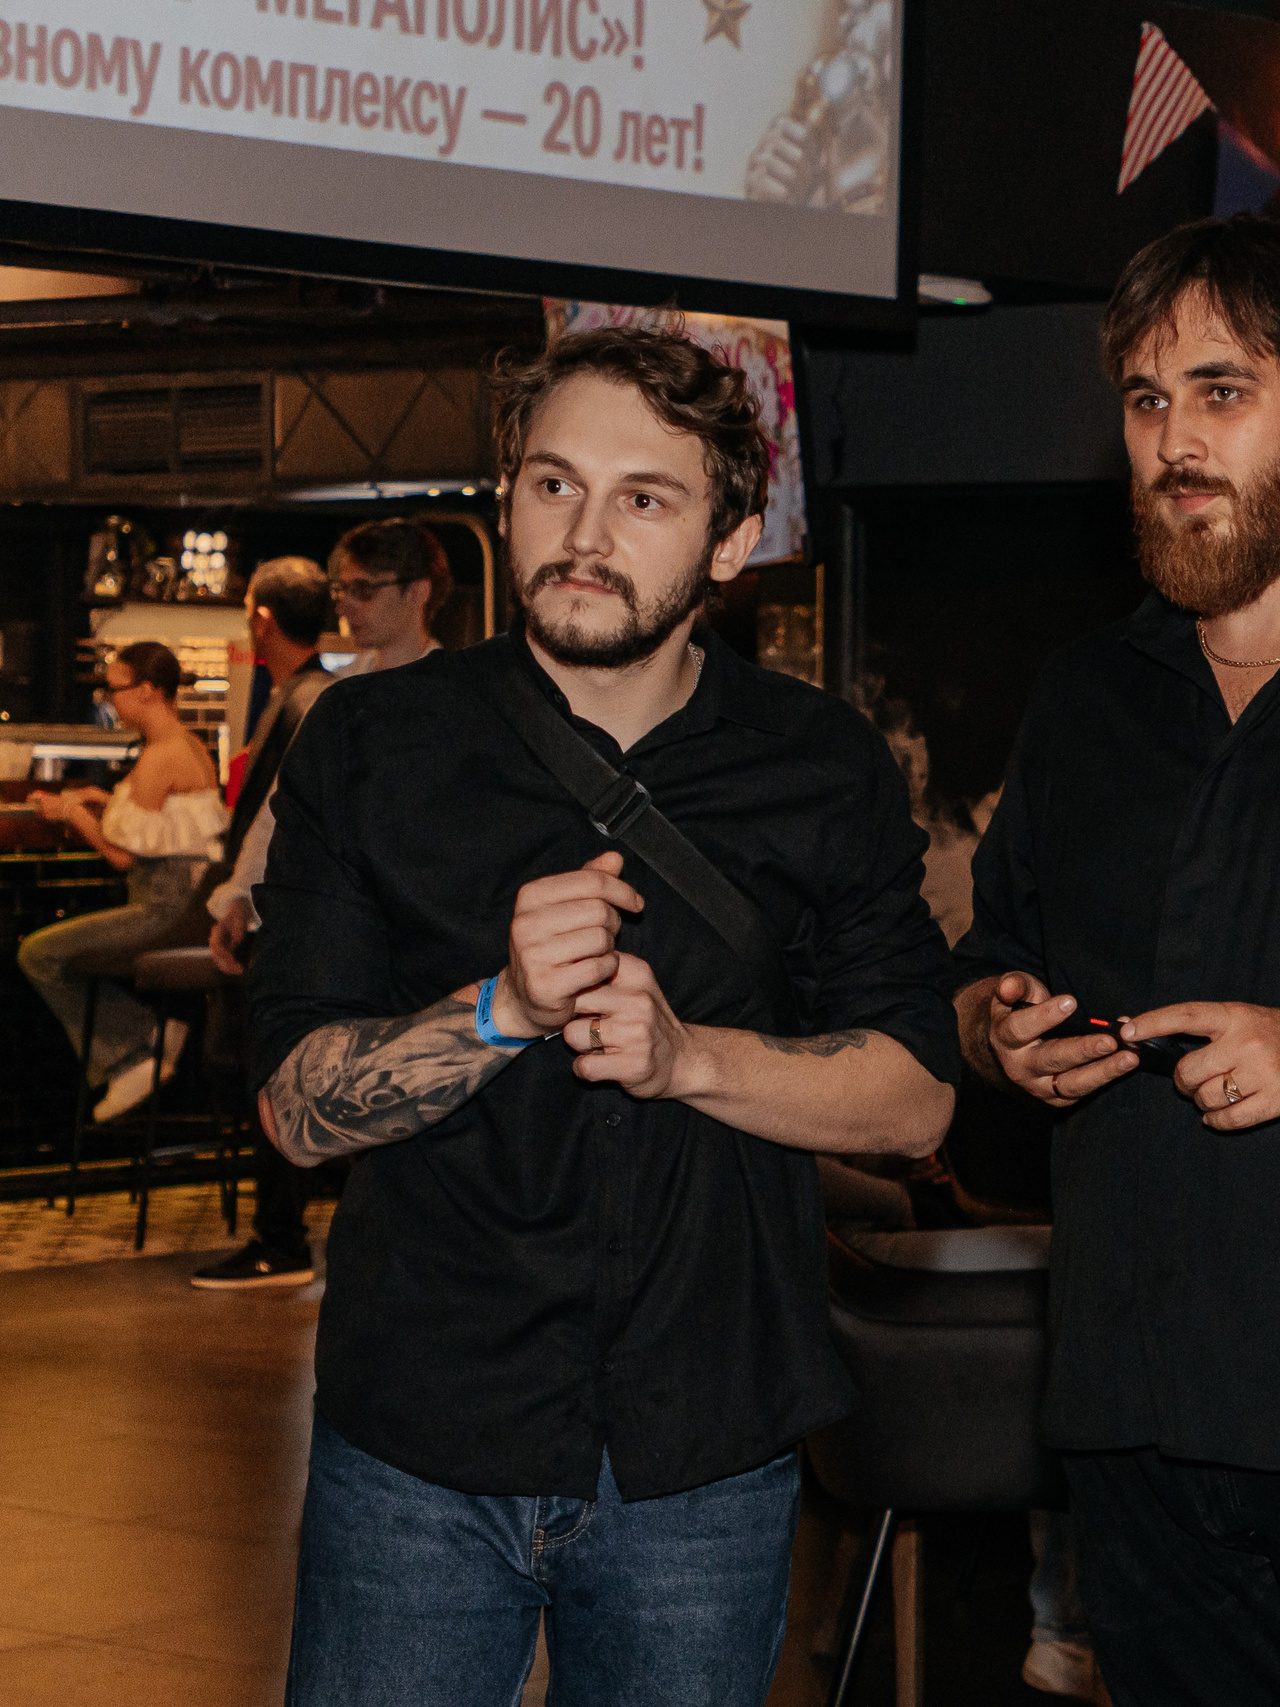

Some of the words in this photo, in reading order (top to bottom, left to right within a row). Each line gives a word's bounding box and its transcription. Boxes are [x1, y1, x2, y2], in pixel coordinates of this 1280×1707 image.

[255, 0, 644, 70] ПОЛИС»!
[179, 46, 467, 155] комплексу
[542, 81, 600, 158] 20
[613, 103, 705, 173] лет!
